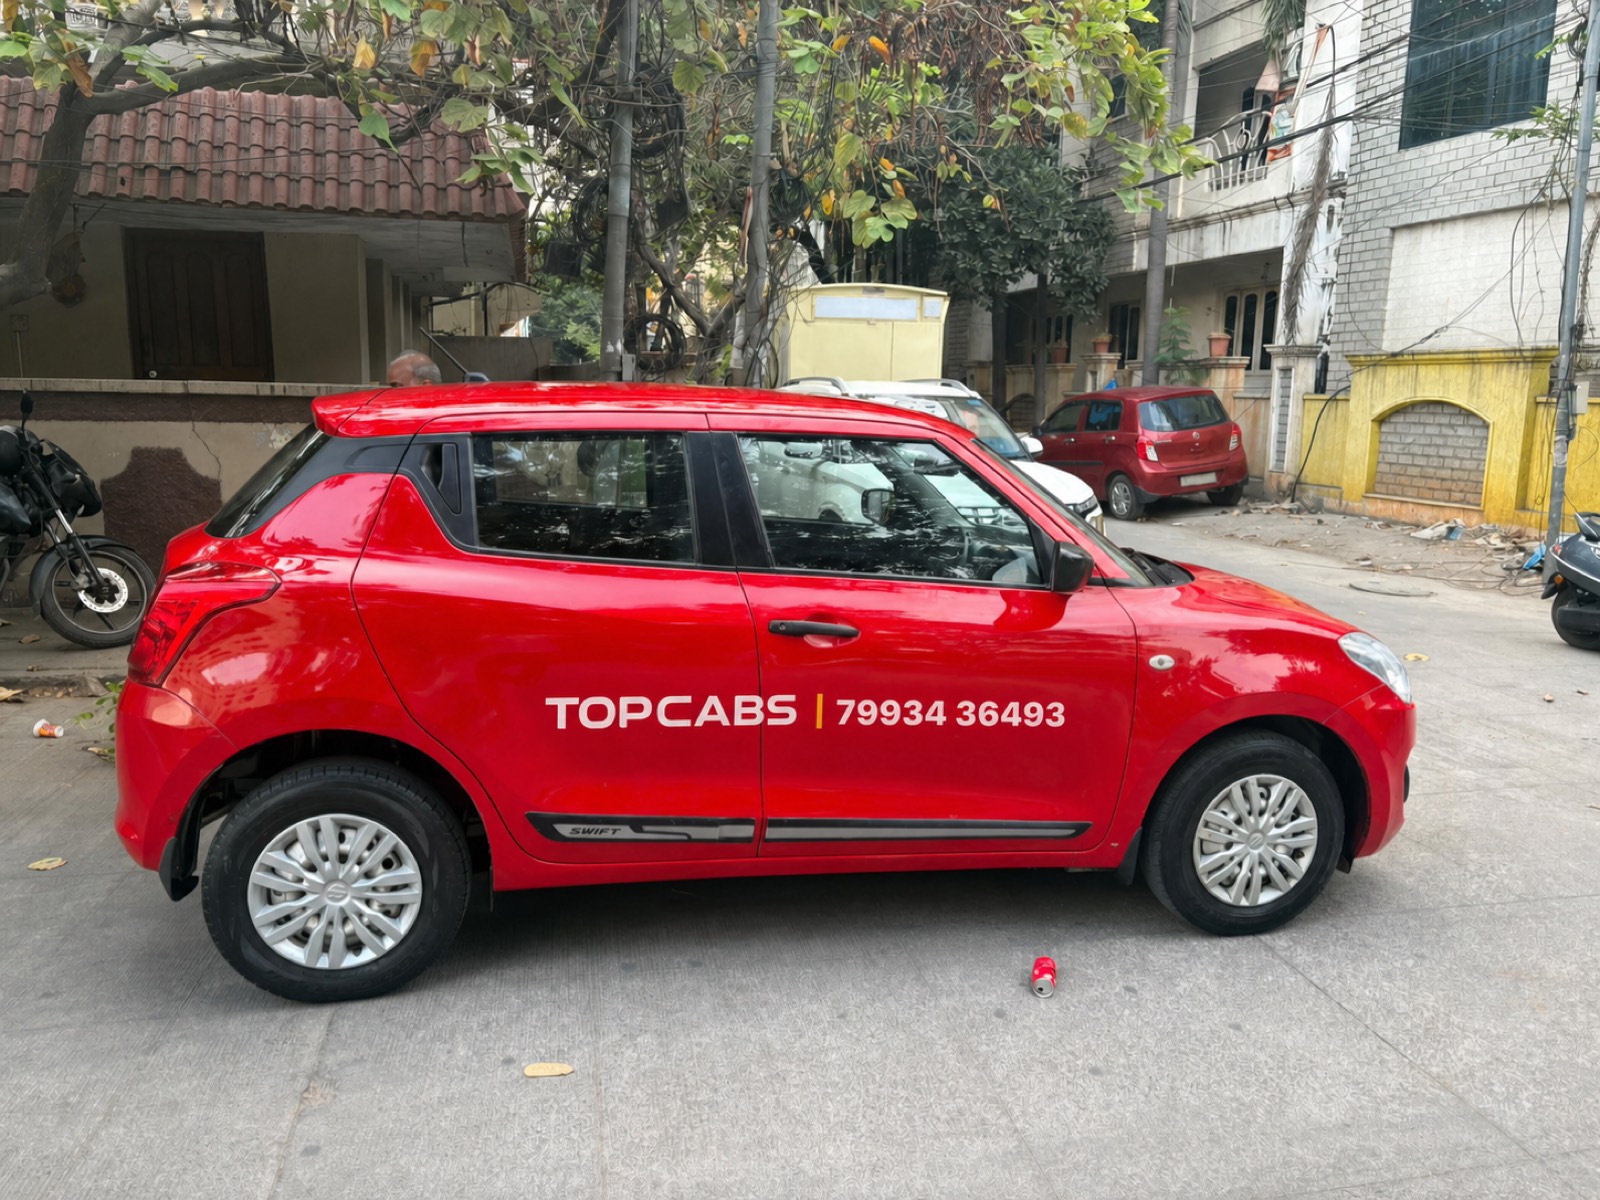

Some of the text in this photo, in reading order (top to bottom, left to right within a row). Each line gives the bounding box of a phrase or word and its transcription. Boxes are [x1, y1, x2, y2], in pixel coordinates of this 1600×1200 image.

[545, 694, 1066, 730] TOPCABS 79934 36493
[569, 827, 622, 836] SWIFT
